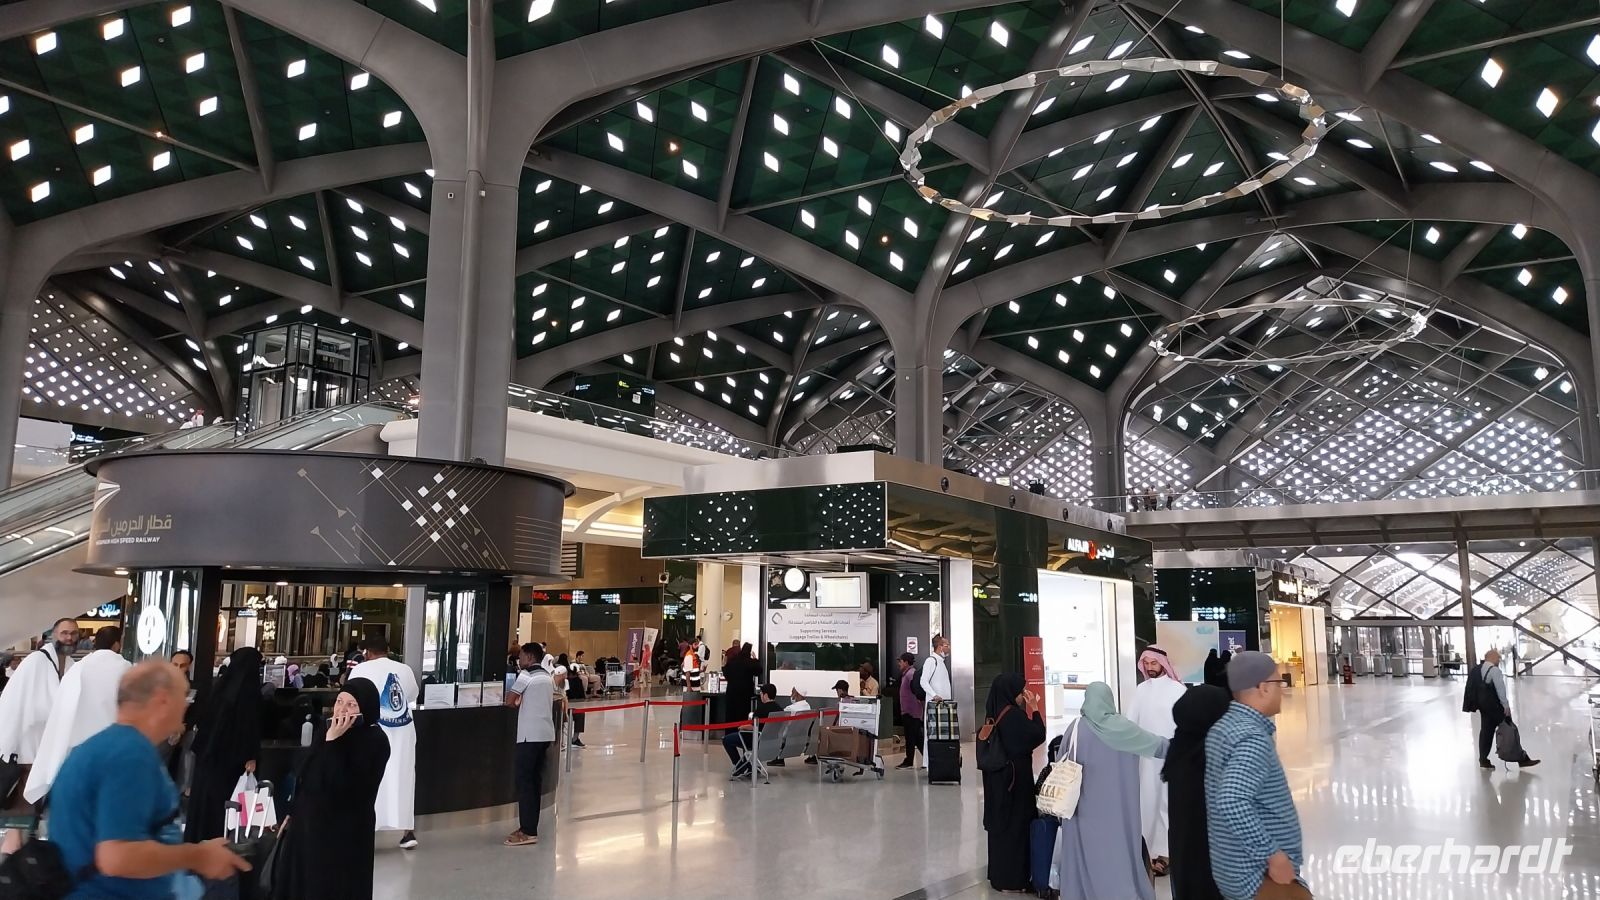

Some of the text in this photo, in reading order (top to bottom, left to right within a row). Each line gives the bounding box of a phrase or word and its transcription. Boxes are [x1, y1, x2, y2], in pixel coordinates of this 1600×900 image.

[111, 515, 144, 537] الحرمين
[144, 514, 172, 535] قطار
[1067, 537, 1090, 554] ALFAJR
